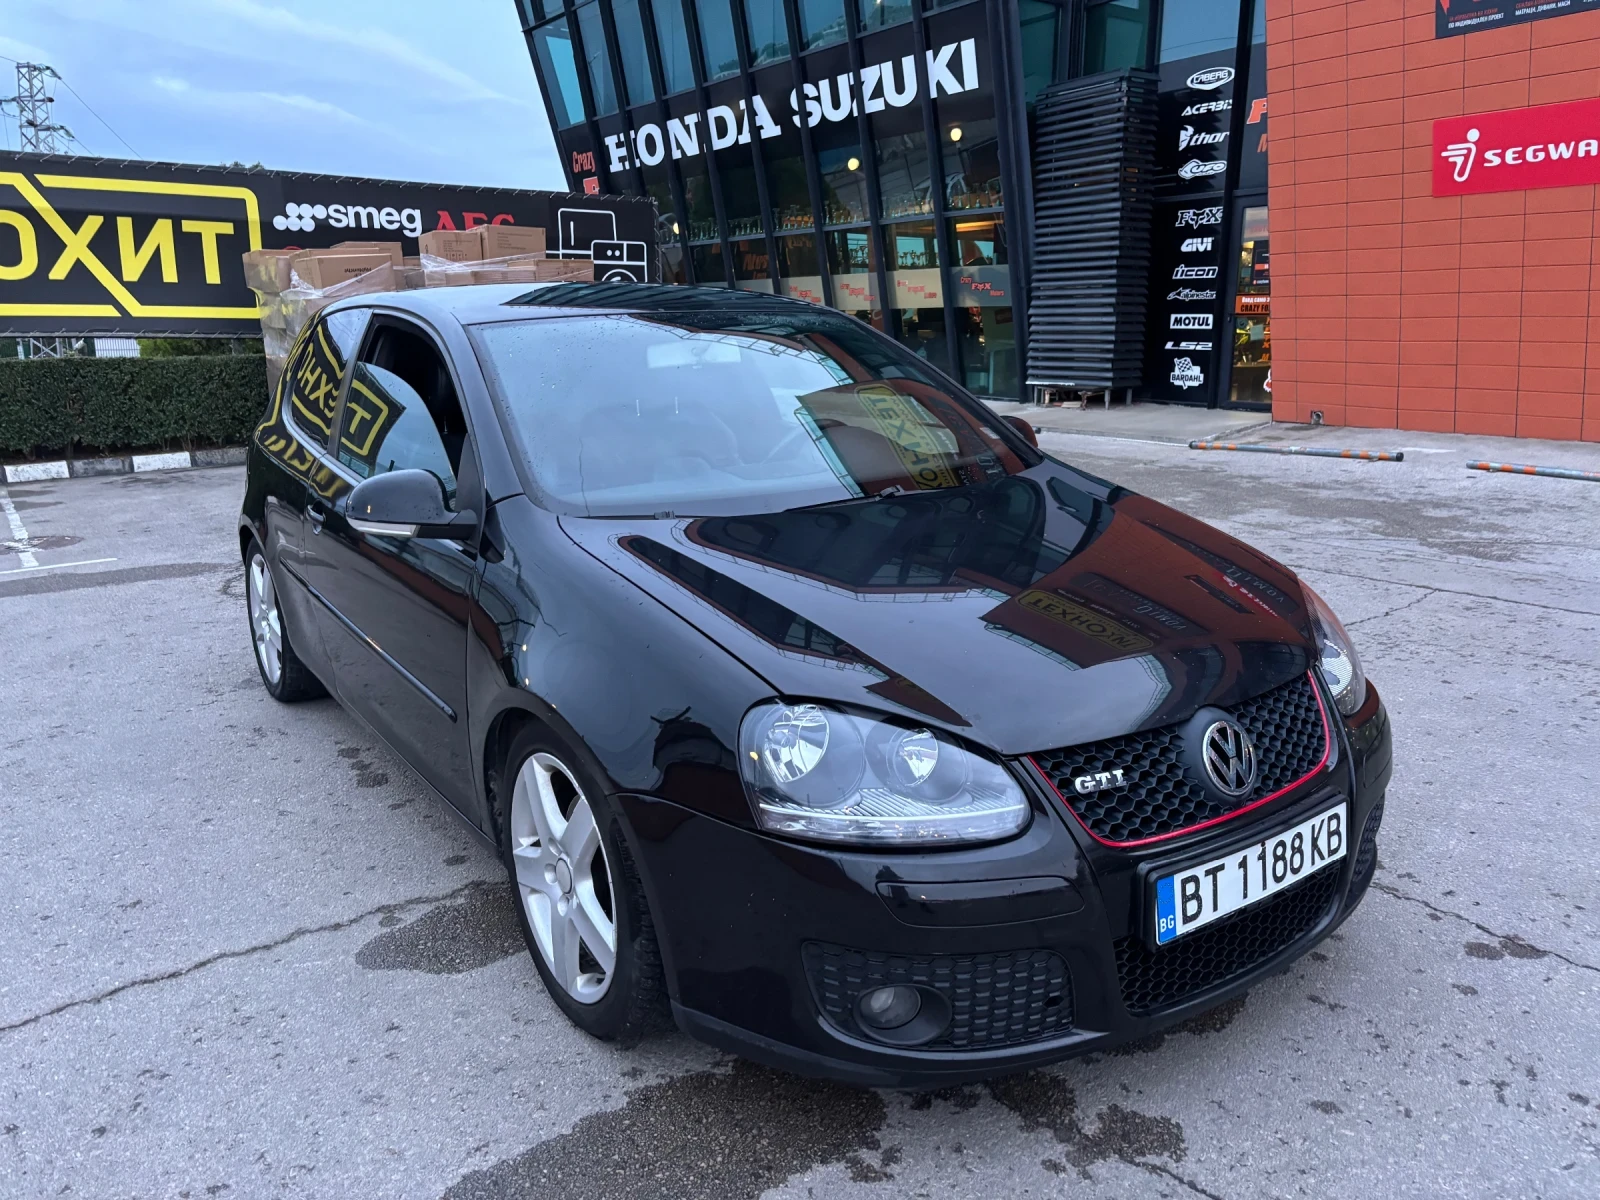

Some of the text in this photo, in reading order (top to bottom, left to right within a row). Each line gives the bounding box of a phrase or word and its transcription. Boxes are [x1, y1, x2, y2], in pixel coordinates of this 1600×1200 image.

[1488, 12, 1504, 22] ПРОЕКТ
[1192, 69, 1229, 84] CABERG
[604, 37, 979, 173] HONDA SUZUKI
[1189, 131, 1230, 146] thor
[572, 151, 596, 173] Crazy
[1190, 163, 1226, 173] UFO
[327, 203, 423, 238] smeg
[1180, 237, 1213, 252] GIVI
[1240, 304, 1260, 313] CRAZY
[1172, 316, 1211, 327] MOTUL
[1164, 341, 1213, 350] LS2
[1171, 374, 1203, 383] BARDAHL
[1074, 769, 1128, 794] GTI
[1180, 812, 1343, 926] BT 1188 KB
[1159, 914, 1175, 933] BG
